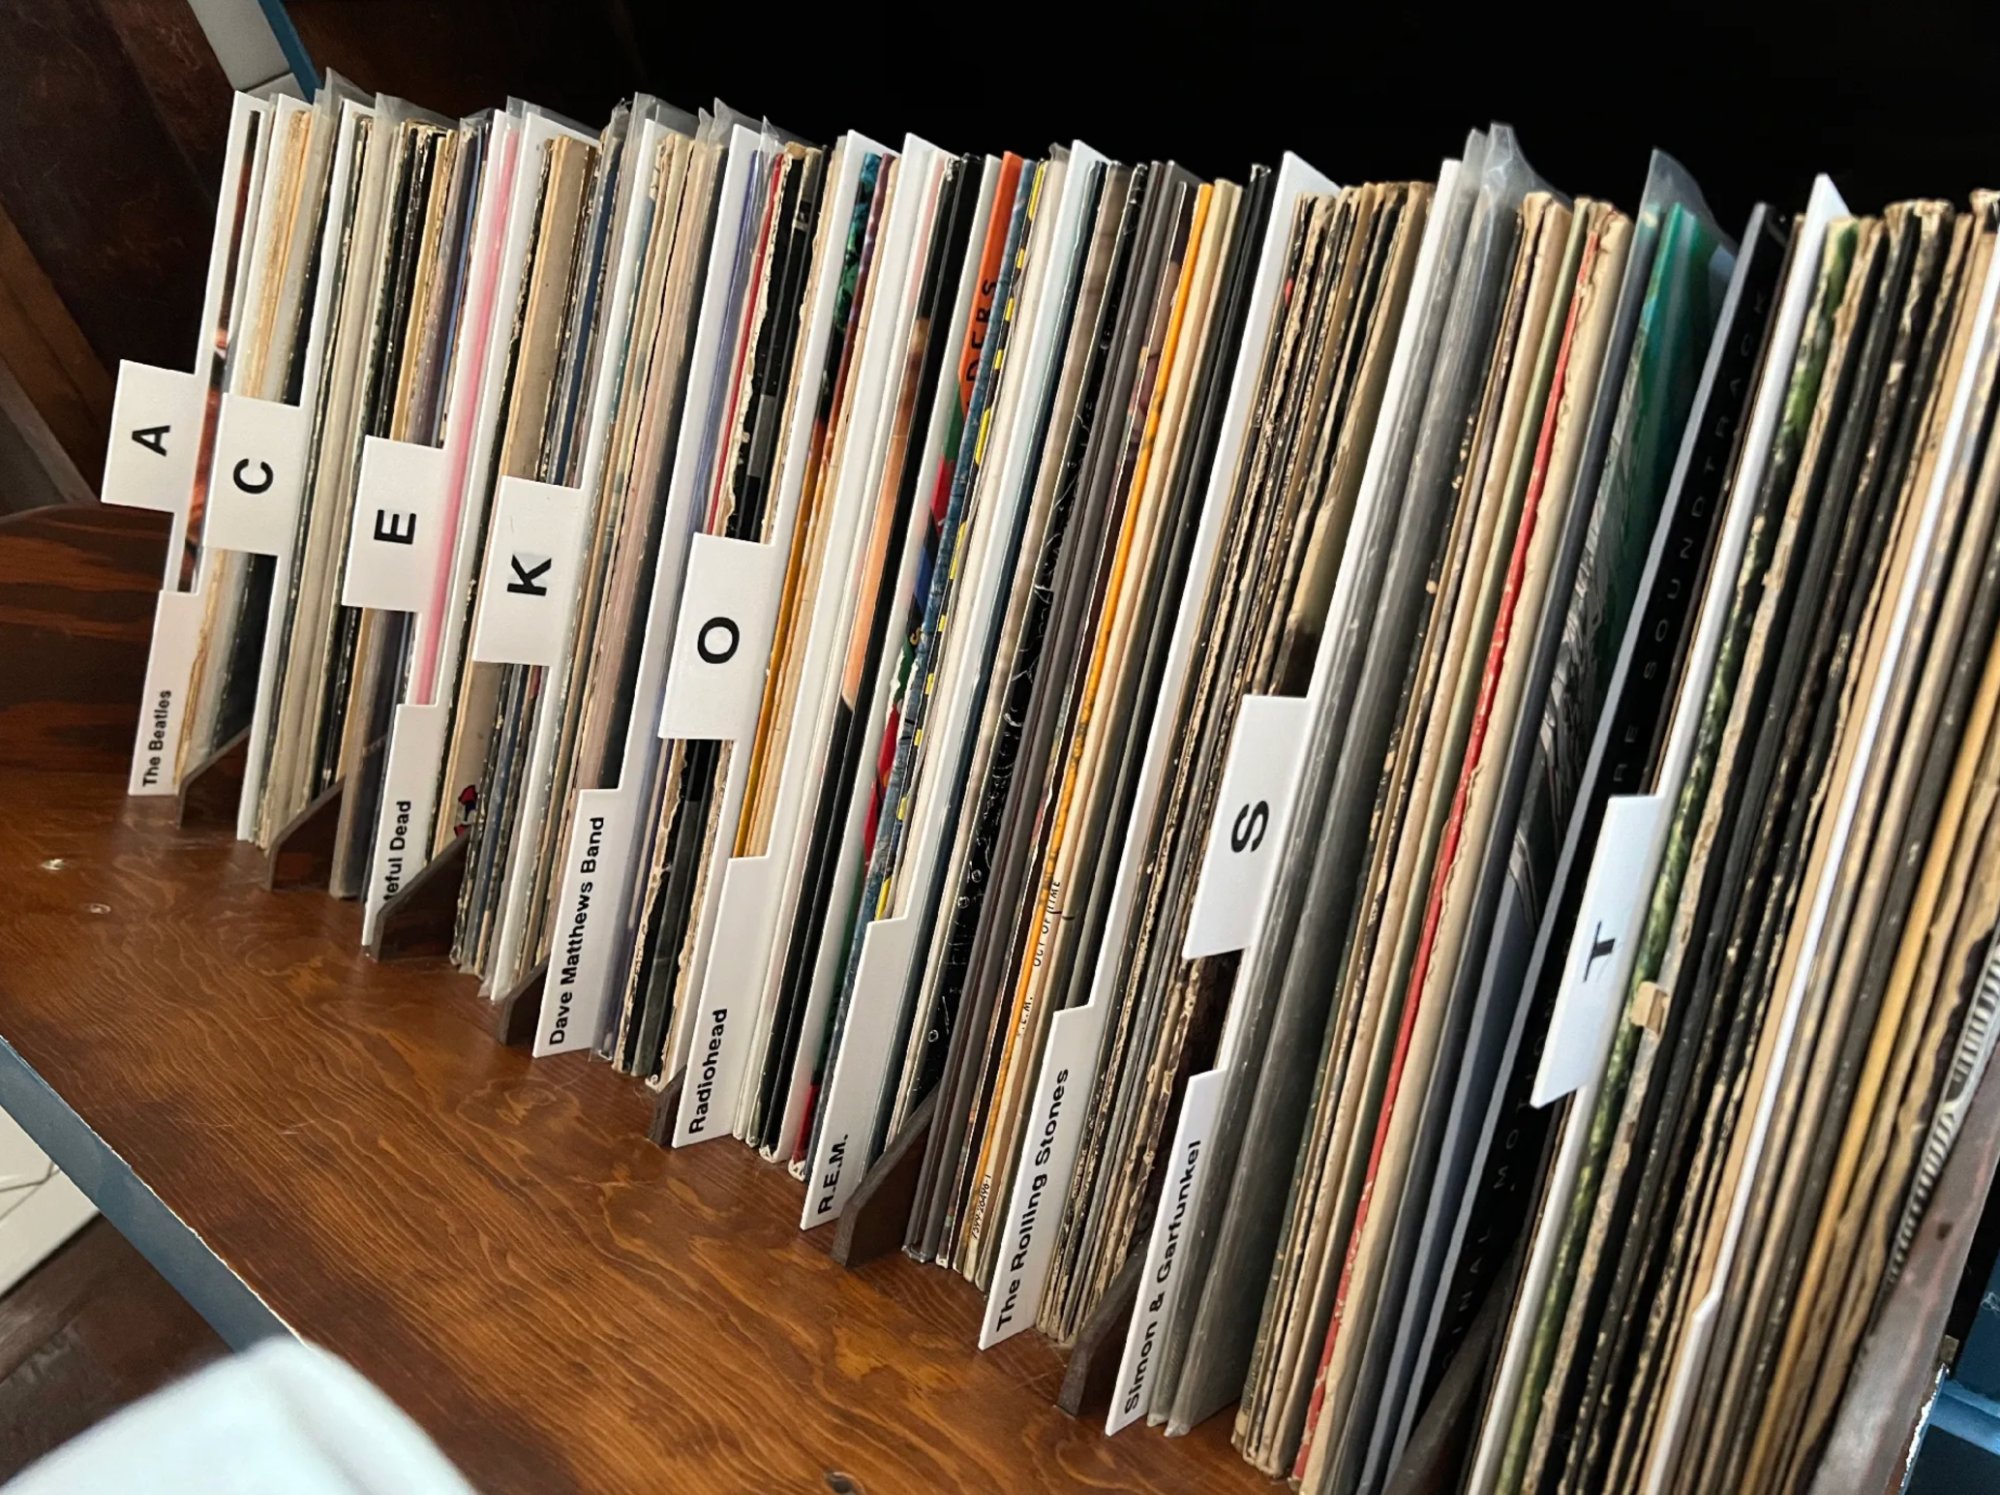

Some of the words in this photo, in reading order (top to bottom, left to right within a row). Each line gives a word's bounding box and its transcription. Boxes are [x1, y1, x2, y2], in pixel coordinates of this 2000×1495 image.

[132, 425, 170, 456] A
[233, 459, 273, 494] C
[1644, 289, 1769, 679] SOUNDTRACK
[374, 510, 416, 545] E
[507, 555, 551, 596] K
[697, 617, 739, 664] O
[147, 690, 171, 752] Beatles
[142, 756, 160, 787] The
[390, 801, 411, 851] Dead
[580, 817, 604, 873] Band
[1231, 801, 1269, 853] S
[560, 882, 593, 985] Matthews
[1584, 922, 1615, 981] T
[549, 992, 572, 1045] Dave
[689, 1009, 727, 1134] Radiohead
[818, 1134, 849, 1215] R.E.M.
[996, 1277, 1022, 1332] The
[1010, 1174, 1047, 1272] Rolling
[1034, 1069, 1068, 1167] Stones
[1124, 1321, 1158, 1414] Simon
[1149, 1291, 1165, 1312] &
[1157, 1141, 1201, 1284] Garfunkel
